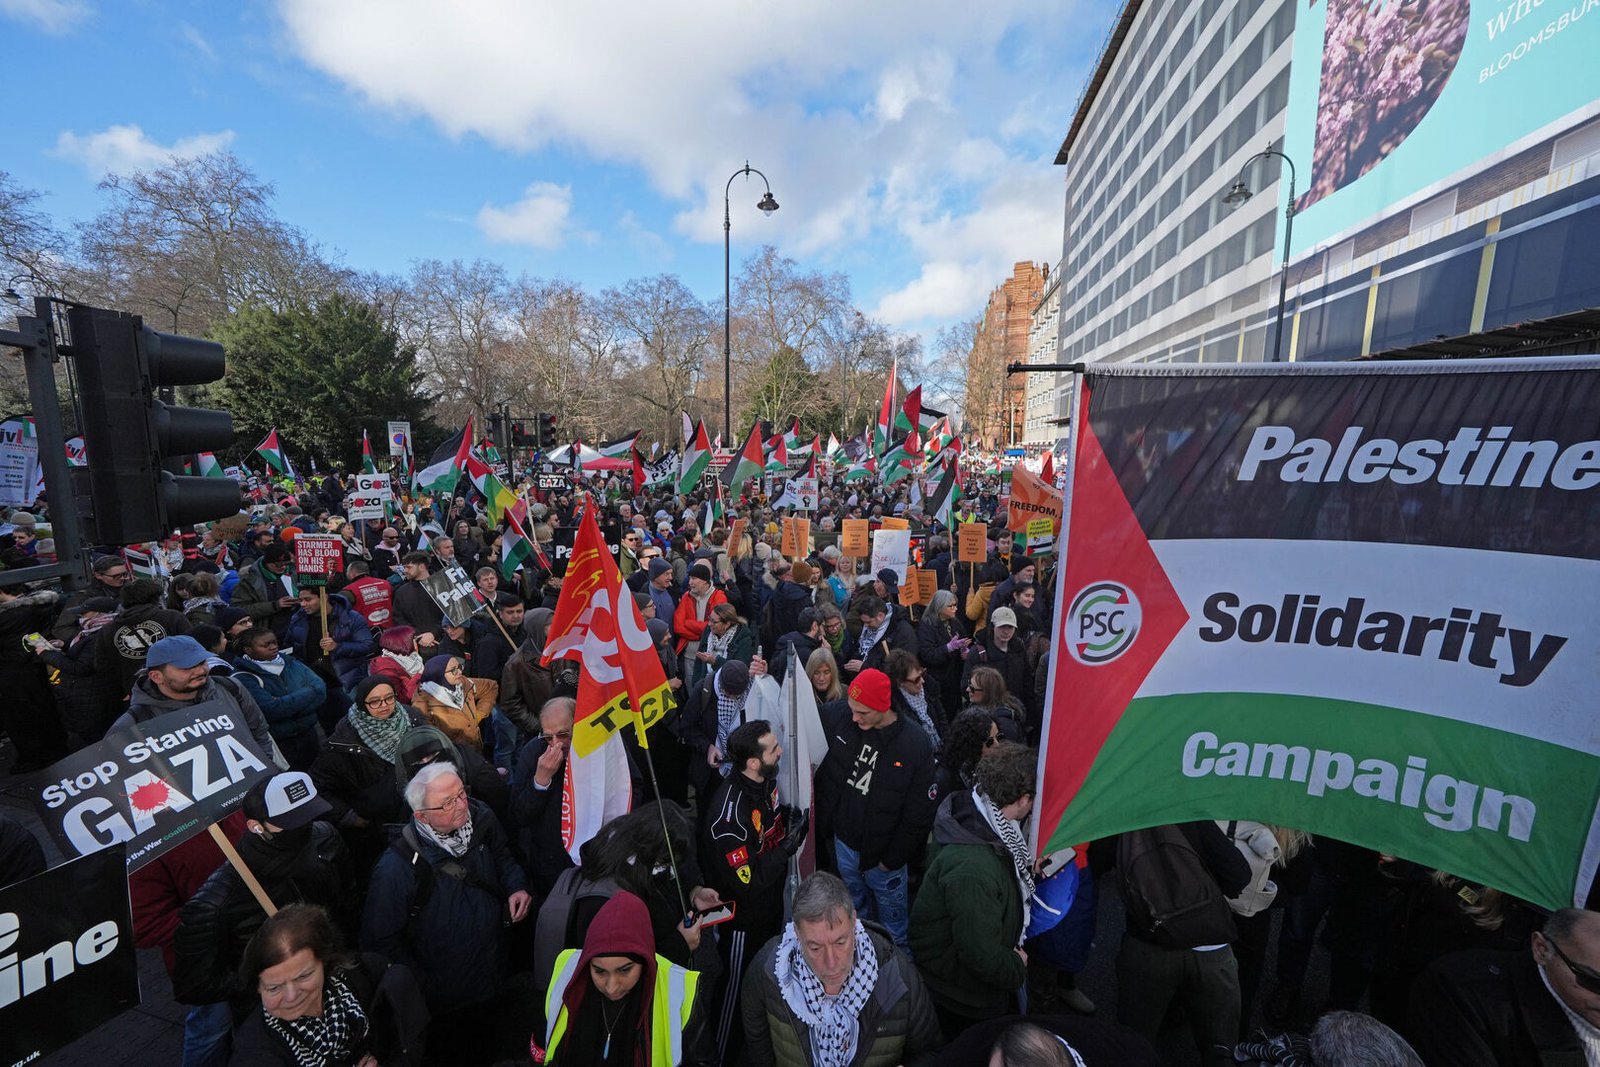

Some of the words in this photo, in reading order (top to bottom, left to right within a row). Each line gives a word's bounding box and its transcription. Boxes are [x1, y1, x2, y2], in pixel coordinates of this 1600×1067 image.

[1237, 426, 1600, 490] Palestine
[540, 479, 565, 487] GAZA
[1010, 500, 1057, 518] FREEDOM,
[437, 580, 476, 607] Pale
[1080, 610, 1124, 638] PSC
[1199, 592, 1568, 687] Solidarity
[42, 760, 119, 808] Stop
[123, 714, 235, 764] Starving
[62, 734, 267, 856] GAZA
[1182, 732, 1536, 842] Campaign
[144, 838, 162, 851] War
[163, 818, 199, 841] coalition
[732, 850, 744, 862] F-1
